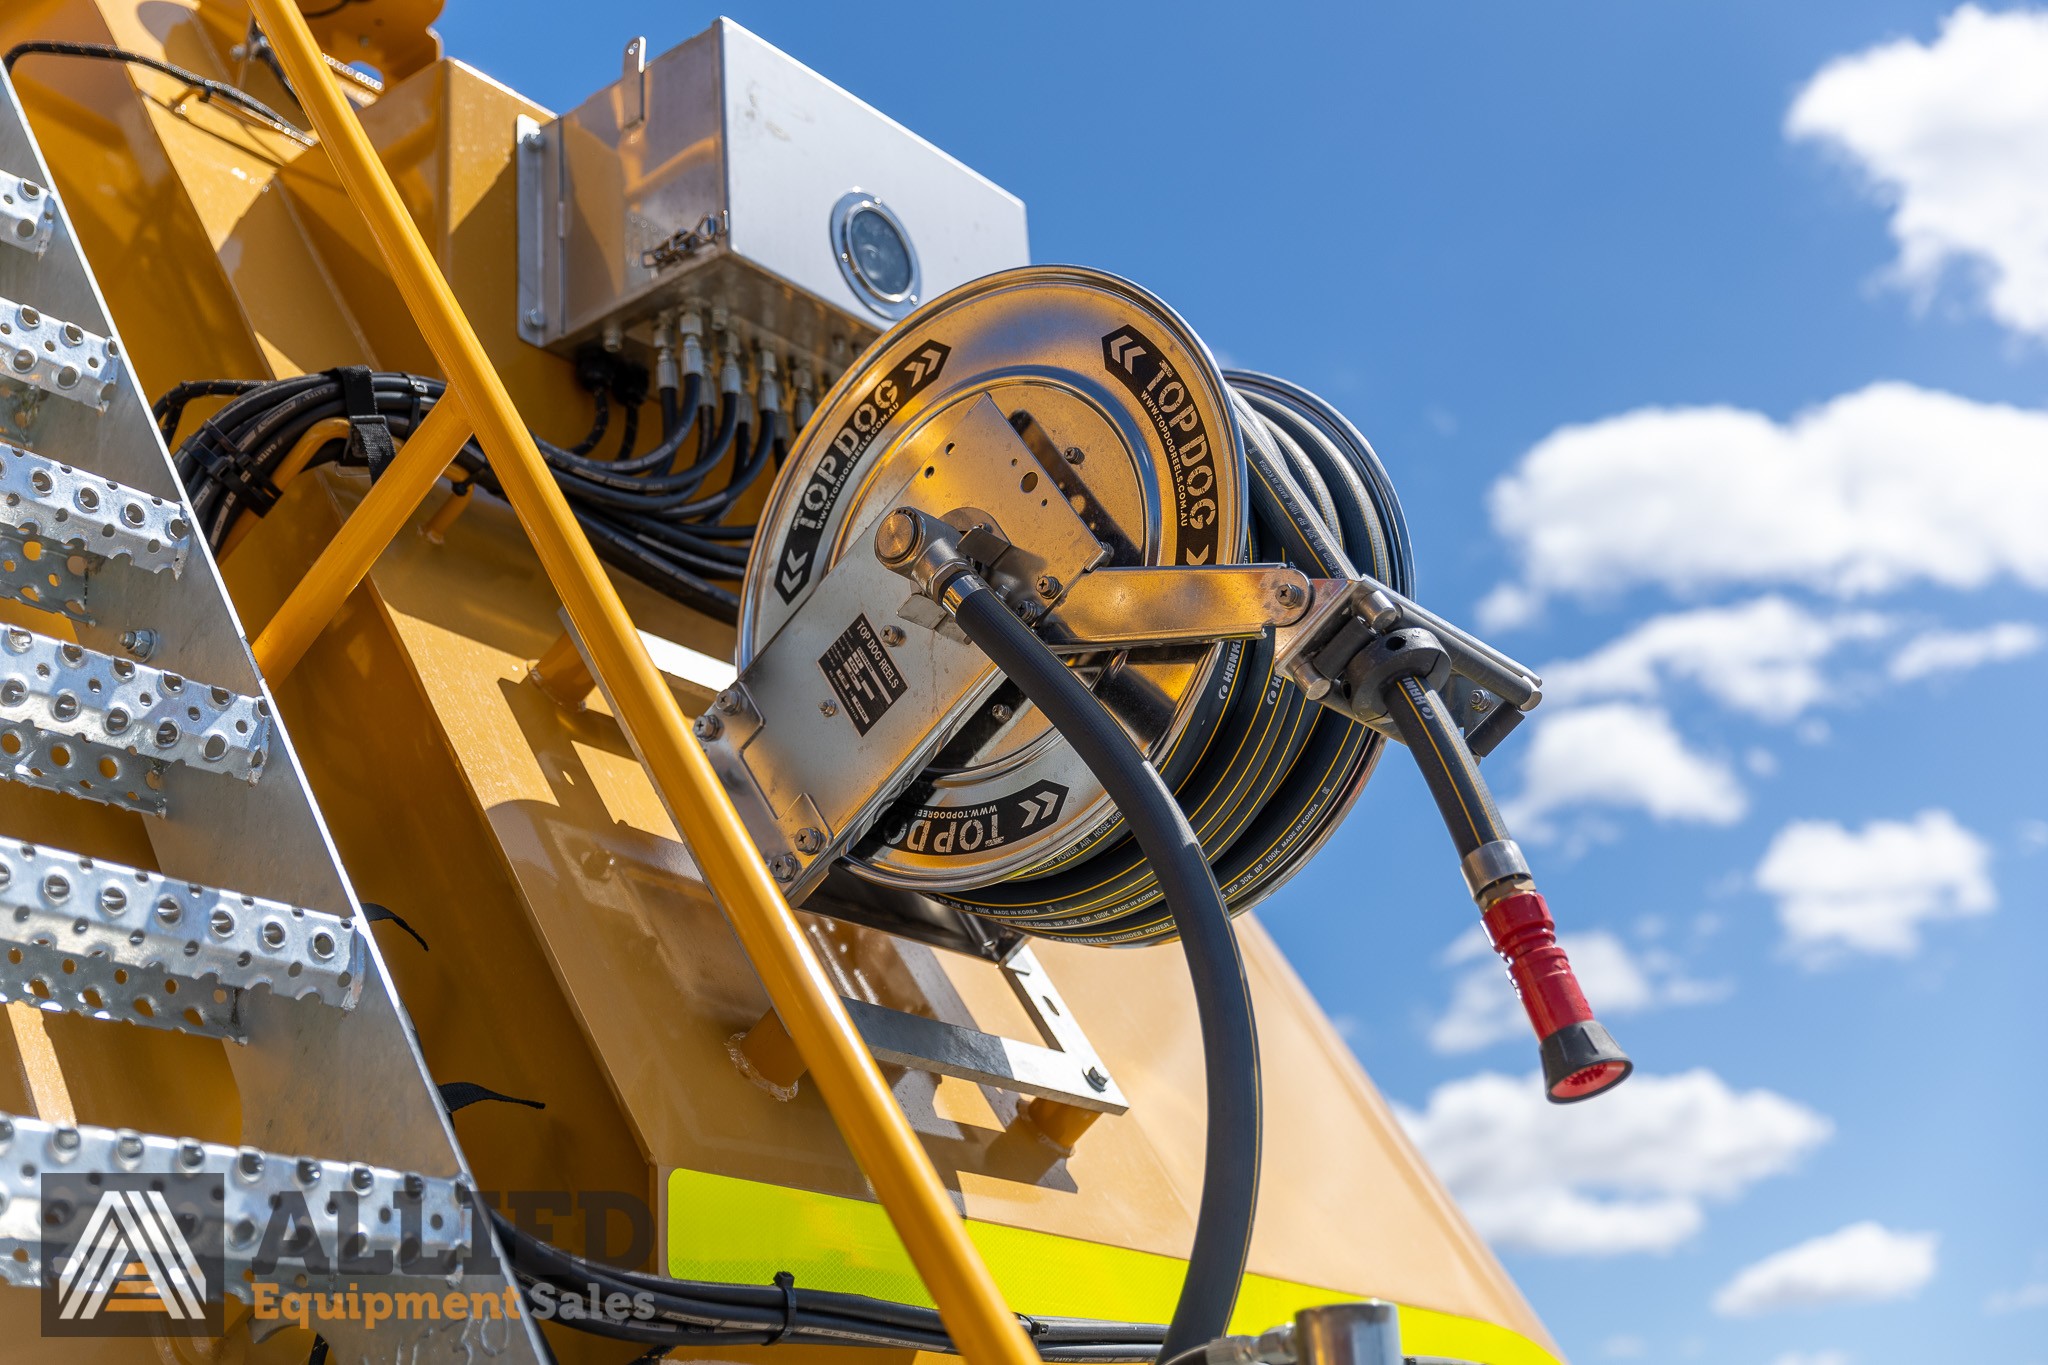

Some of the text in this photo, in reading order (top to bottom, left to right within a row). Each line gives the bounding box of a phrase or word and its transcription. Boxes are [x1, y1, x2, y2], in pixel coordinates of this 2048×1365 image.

[815, 402, 900, 531] WWW.TOPDOGREELS.COM.AU
[1140, 389, 1188, 527] WWW.TOPDOGREELS.COM.AU
[1258, 459, 1273, 478] KOREA
[855, 619, 871, 642] TOP
[866, 638, 883, 661] DOG
[878, 658, 899, 689] REELS
[1056, 847, 1079, 862] POWER
[1080, 838, 1092, 848] AIR
[1094, 822, 1111, 837] HOSE
[1226, 802, 1320, 894] WP 30K BP 100K MADE IN KOREA
[1094, 910, 1110, 920] 100K
[1112, 904, 1130, 914] MADE
[1138, 889, 1158, 903] KOREA
[1111, 931, 1142, 941] THUNDER
[1145, 922, 1170, 934] POWER
